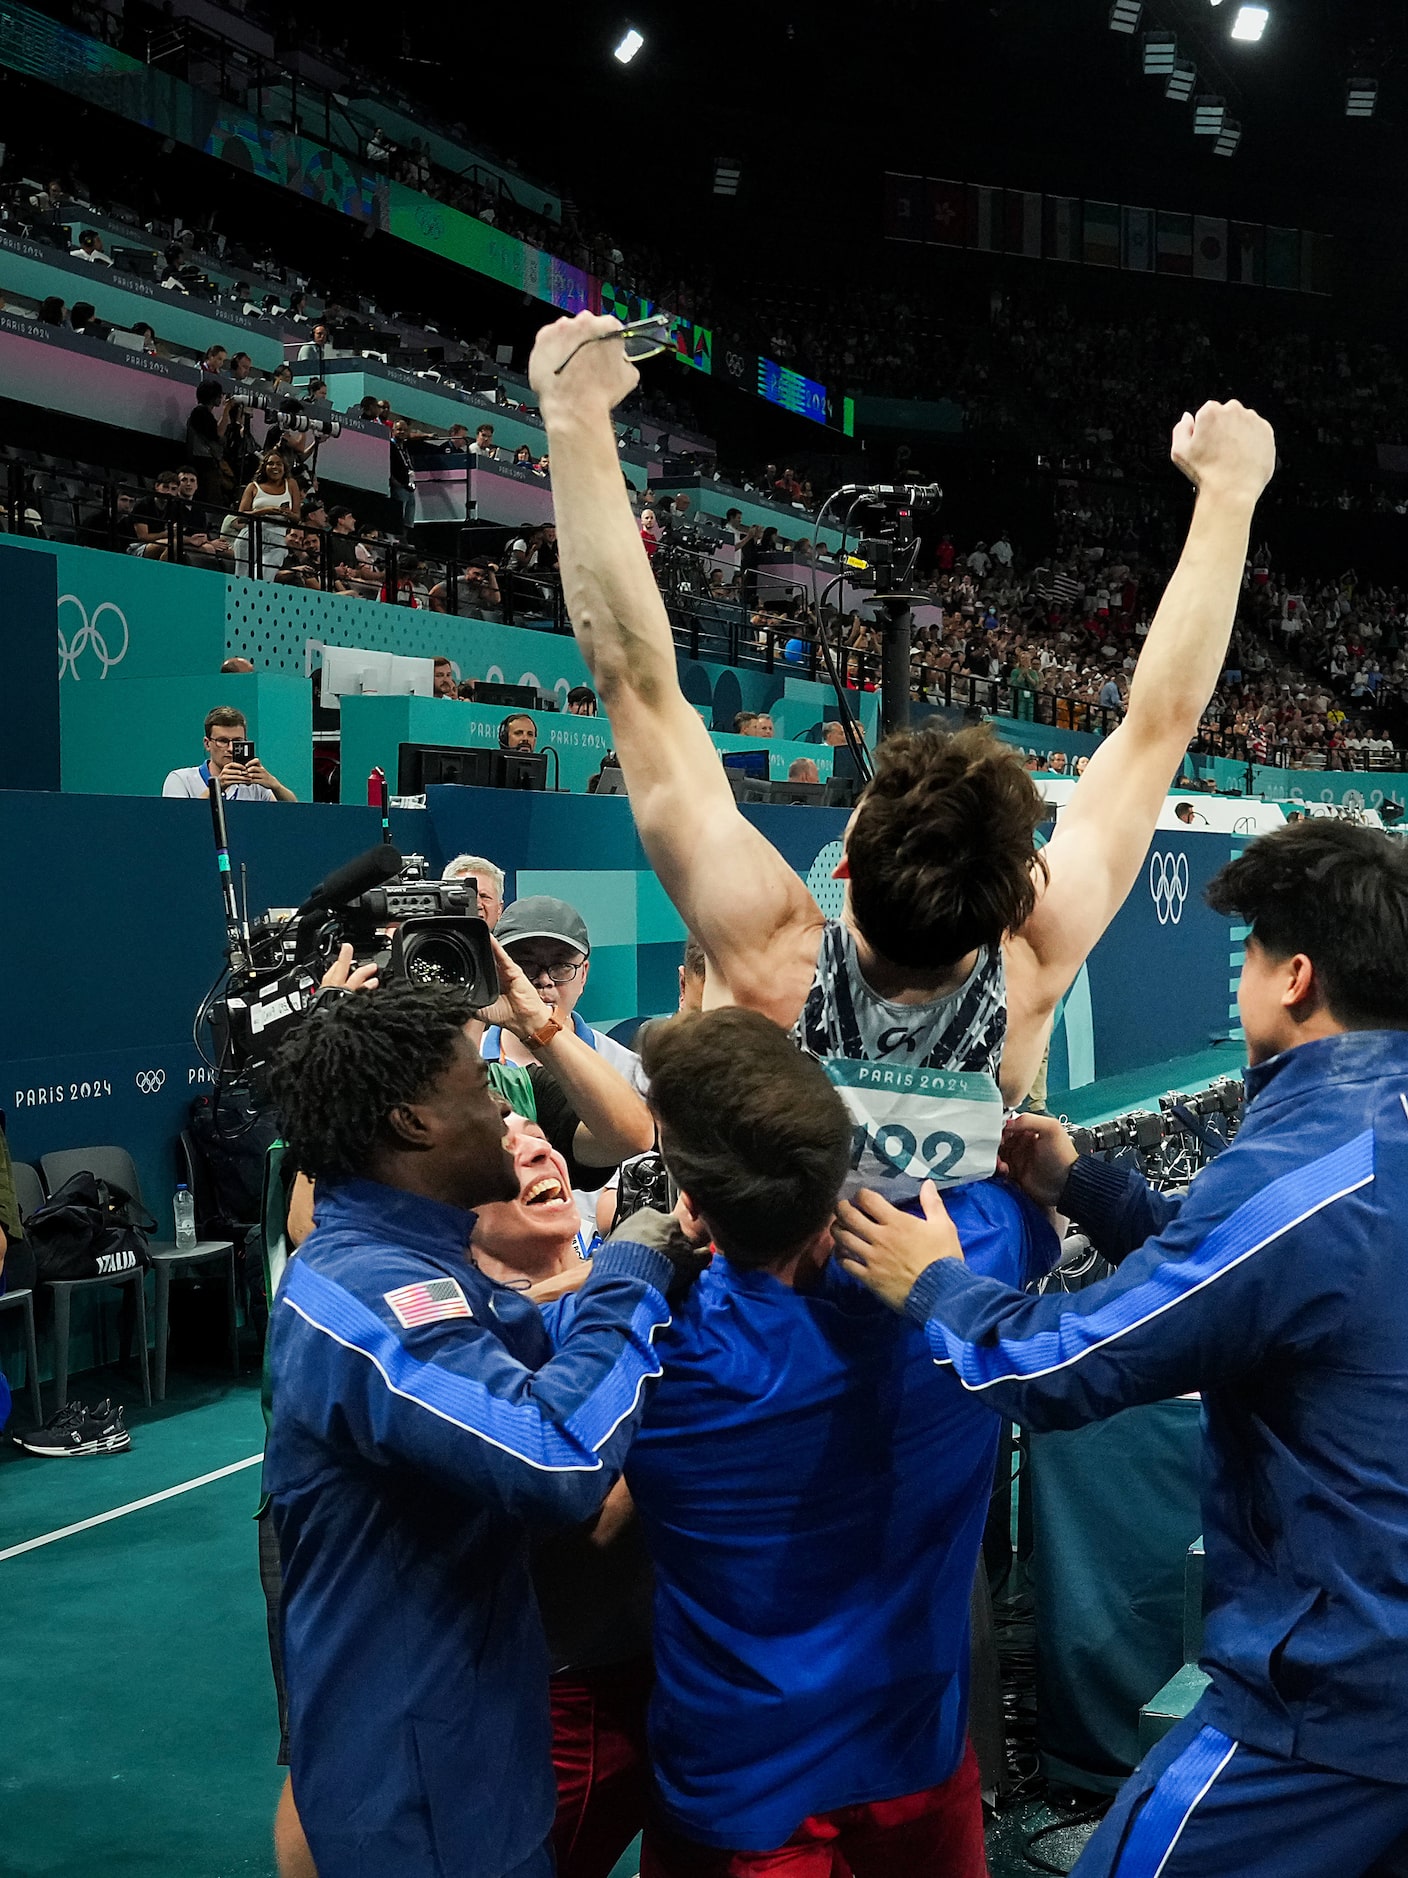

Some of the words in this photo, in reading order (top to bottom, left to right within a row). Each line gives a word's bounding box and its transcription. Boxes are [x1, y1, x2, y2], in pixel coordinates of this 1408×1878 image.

[582, 734, 606, 749] 2024
[69, 1079, 112, 1101] 2024
[919, 1075, 968, 1092] 2024
[96, 1250, 137, 1275] ITALIA
